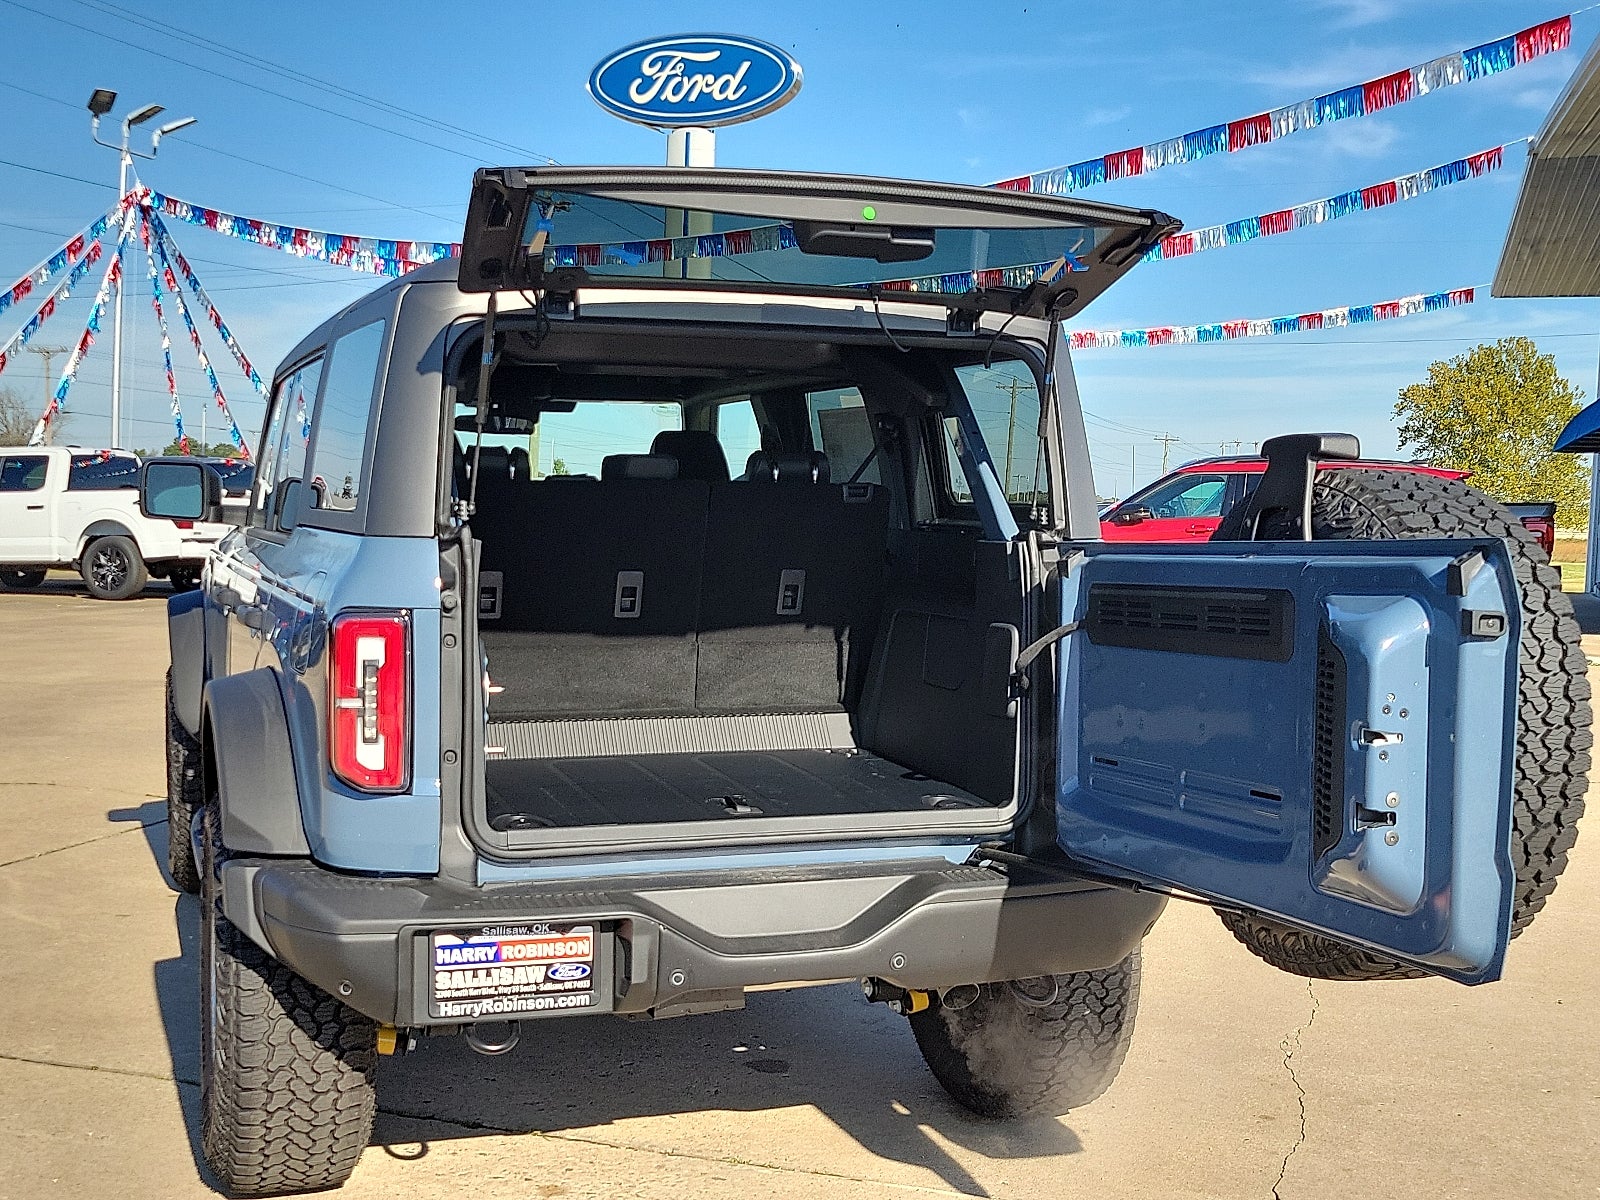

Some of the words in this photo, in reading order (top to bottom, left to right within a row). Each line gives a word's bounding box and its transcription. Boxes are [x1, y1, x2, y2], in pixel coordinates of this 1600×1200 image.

[629, 50, 751, 104] Ford
[532, 923, 550, 933] OK
[435, 945, 498, 965] HARRY
[501, 940, 590, 960] ROBINSON
[435, 964, 547, 990] SALLISAW
[439, 994, 590, 1018] HarryRobinson.com
